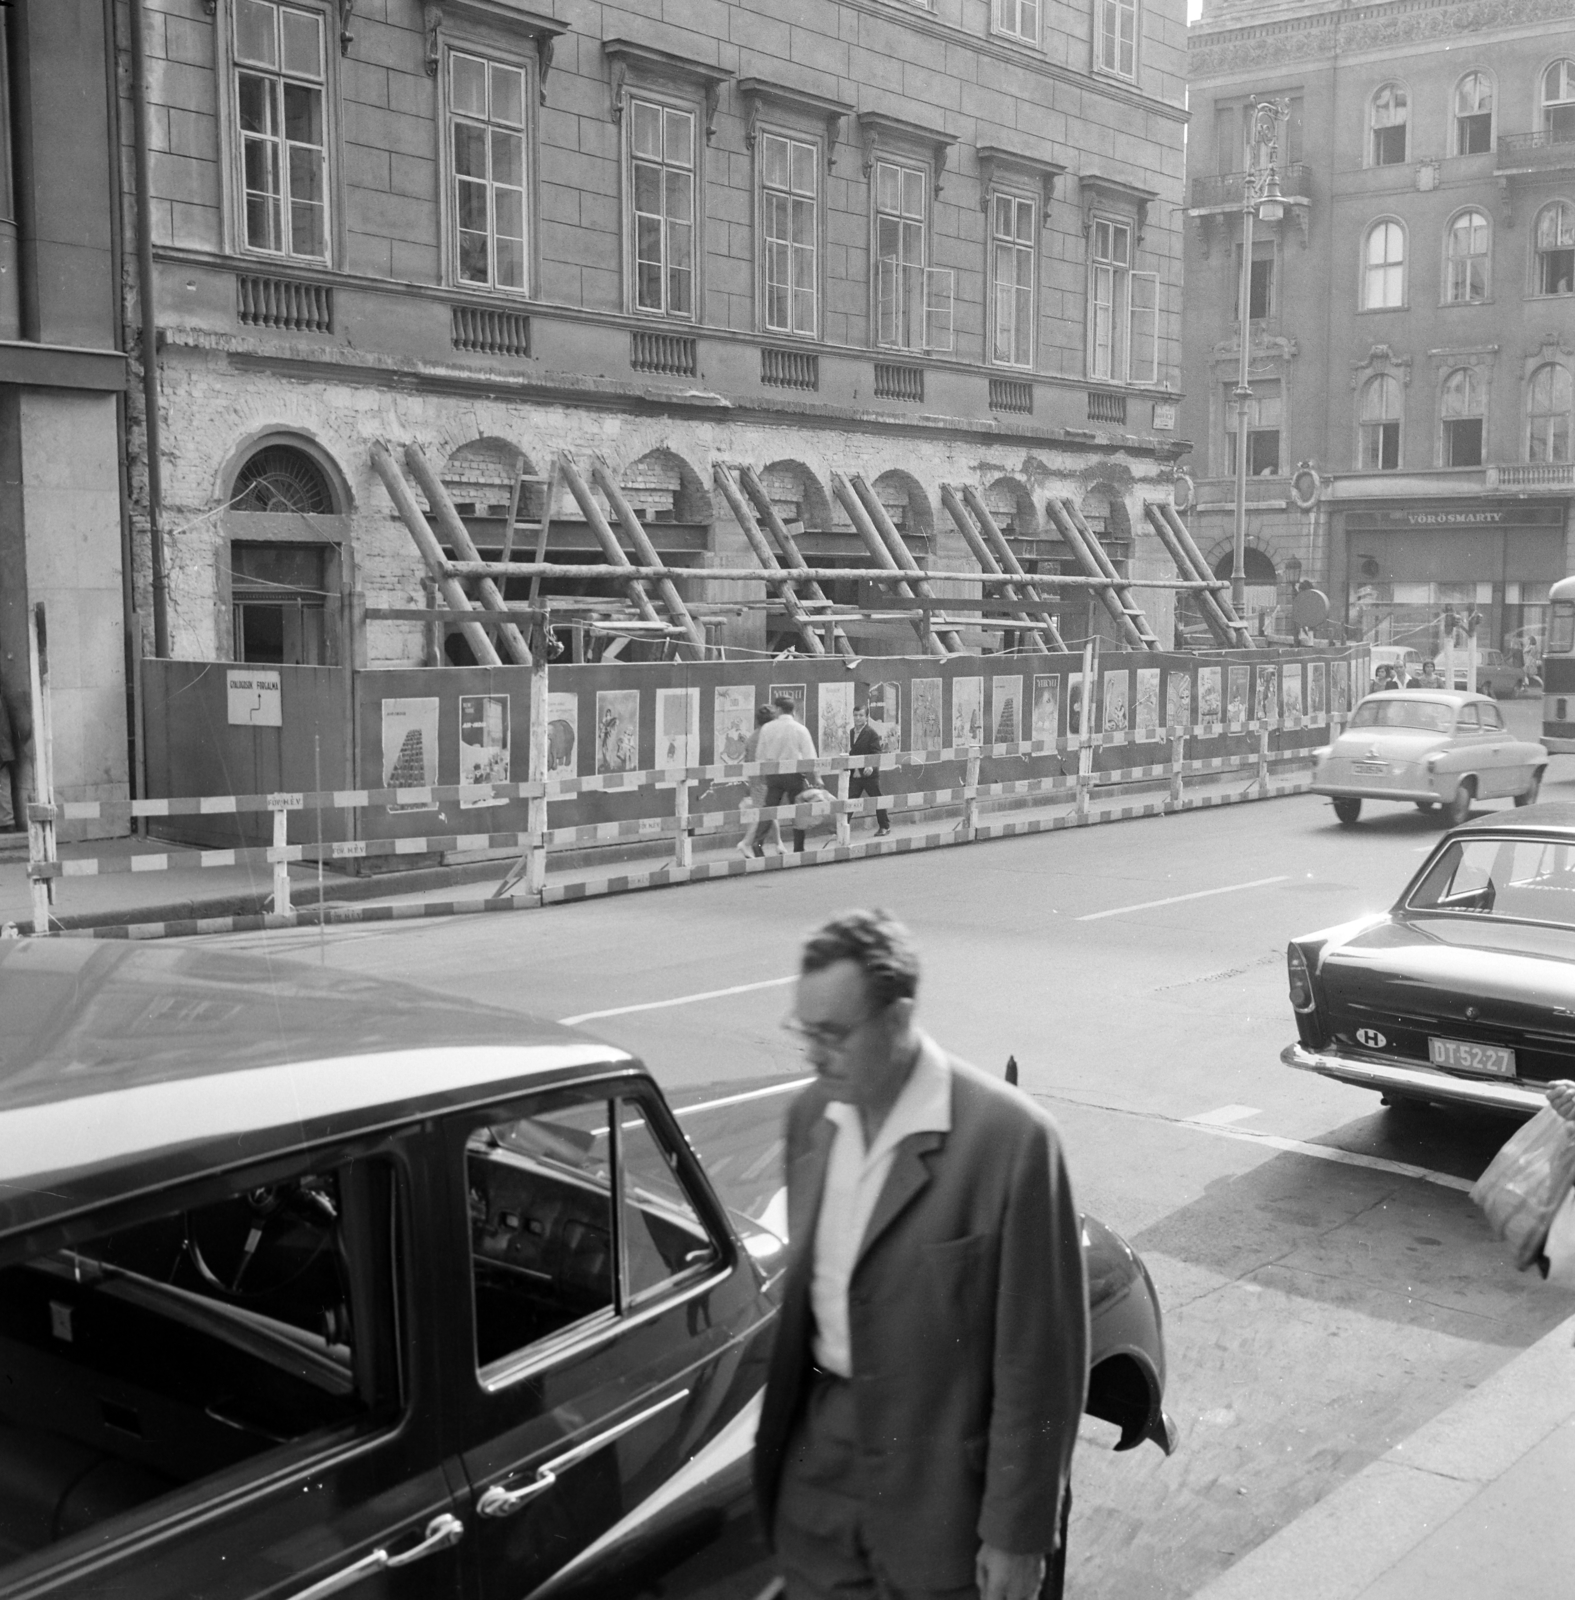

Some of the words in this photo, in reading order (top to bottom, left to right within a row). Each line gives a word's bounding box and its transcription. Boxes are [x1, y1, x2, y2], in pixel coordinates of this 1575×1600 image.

[1408, 512, 1502, 524] VÖRÖSMARTY
[256, 681, 279, 690] FORGALMA
[1364, 1030, 1379, 1046] H
